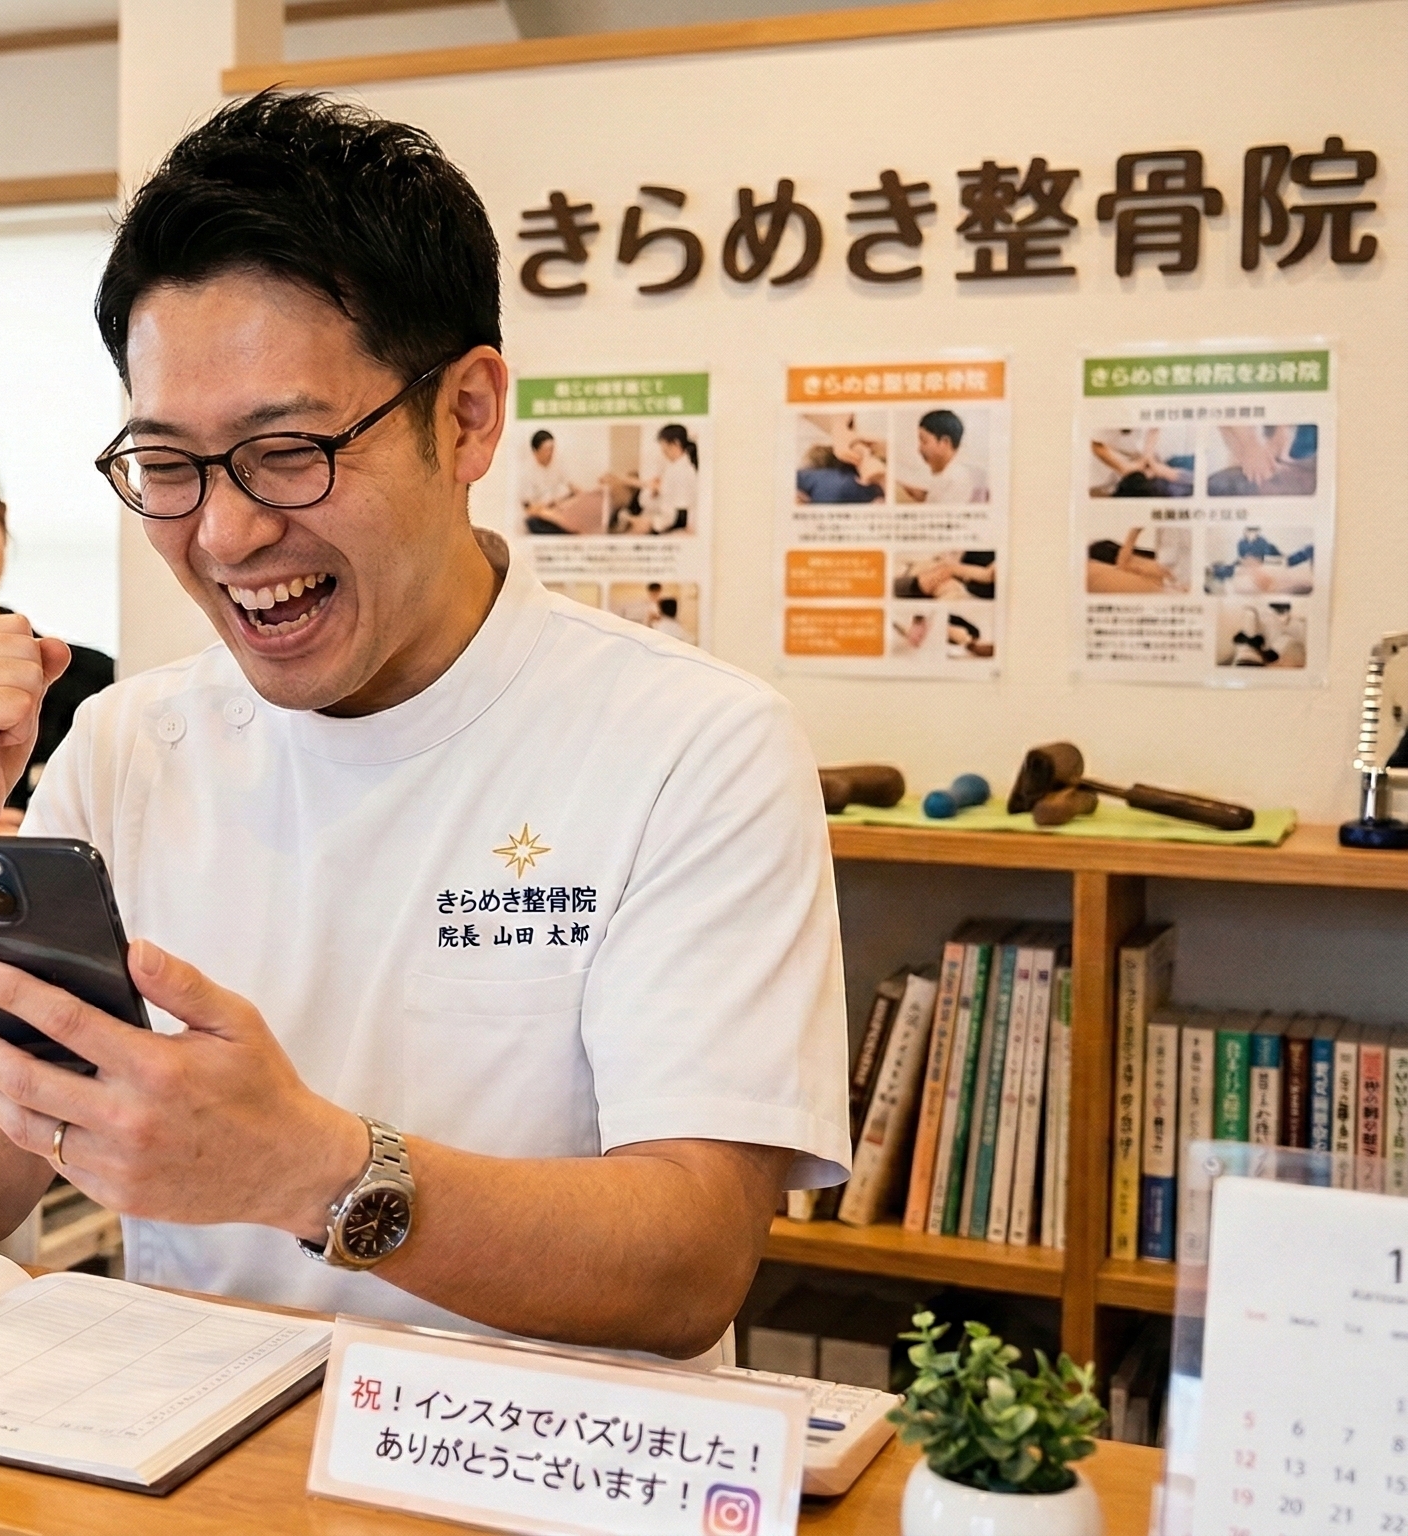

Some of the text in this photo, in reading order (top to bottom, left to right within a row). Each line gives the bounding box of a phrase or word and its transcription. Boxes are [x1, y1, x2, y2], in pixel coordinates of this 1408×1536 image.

[518, 136, 1378, 297] きらめき整骨院
[437, 885, 597, 914] きらめき整骨院
[438, 922, 590, 948] 院長 山田 太郎
[1292, 1419, 1303, 1436] 6
[1344, 1428, 1355, 1444] 7
[1393, 1437, 1405, 1453] 8
[1234, 1449, 1408, 1494] 12 13 14 15
[1233, 1487, 1406, 1534] 19 20 21 22
